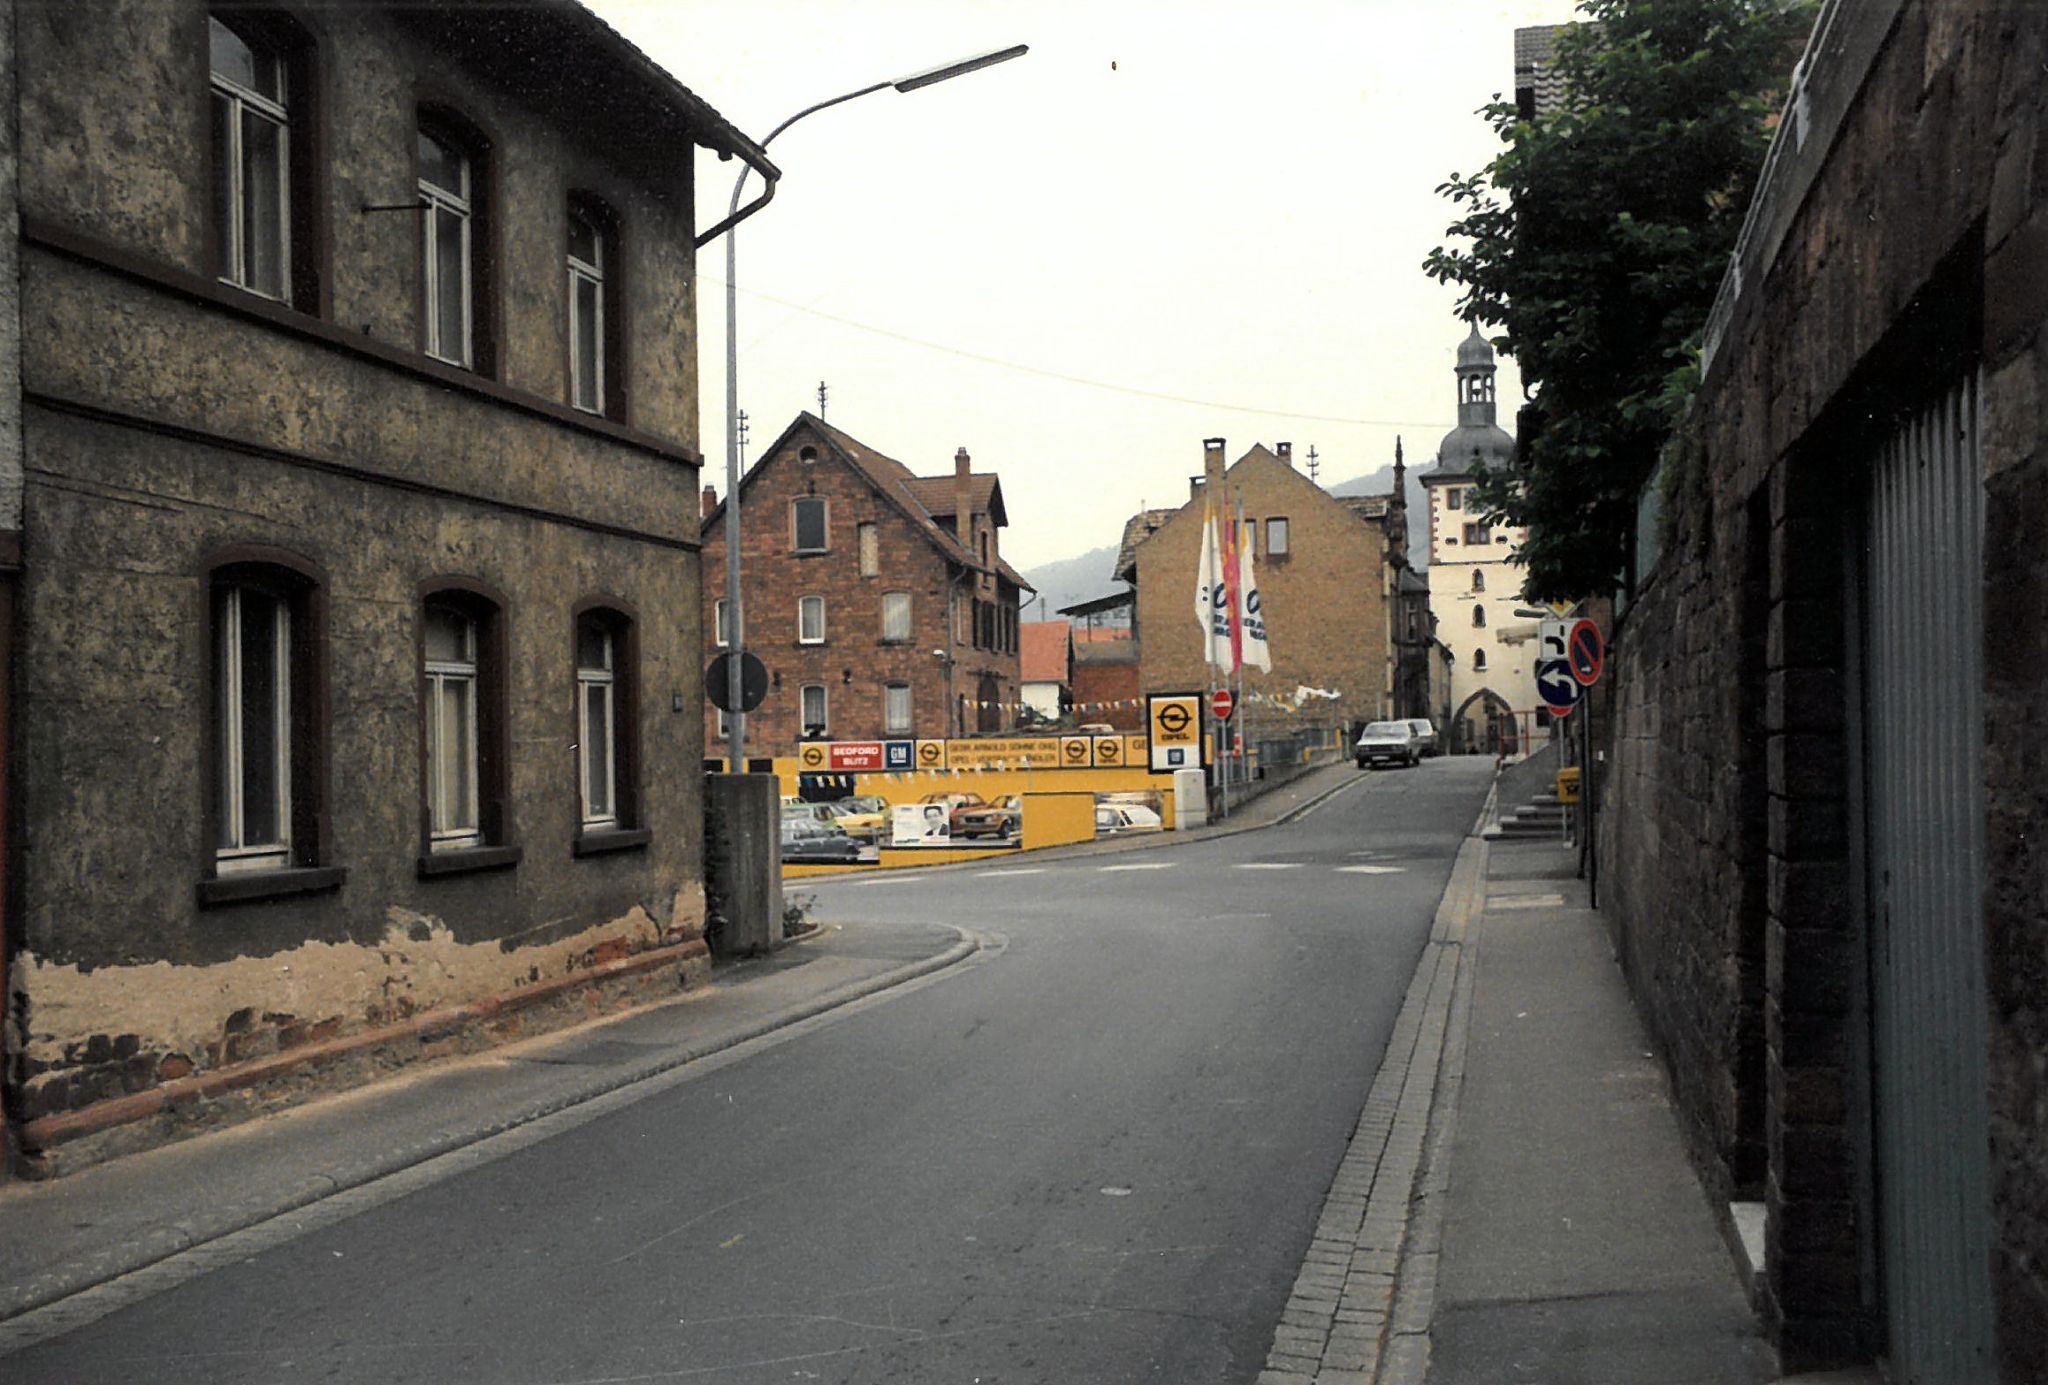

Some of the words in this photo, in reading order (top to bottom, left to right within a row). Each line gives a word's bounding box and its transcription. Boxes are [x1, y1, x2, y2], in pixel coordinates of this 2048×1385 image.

[833, 746, 879, 756] BEDFORD
[890, 747, 907, 760] GM
[842, 757, 869, 766] BLITZ
